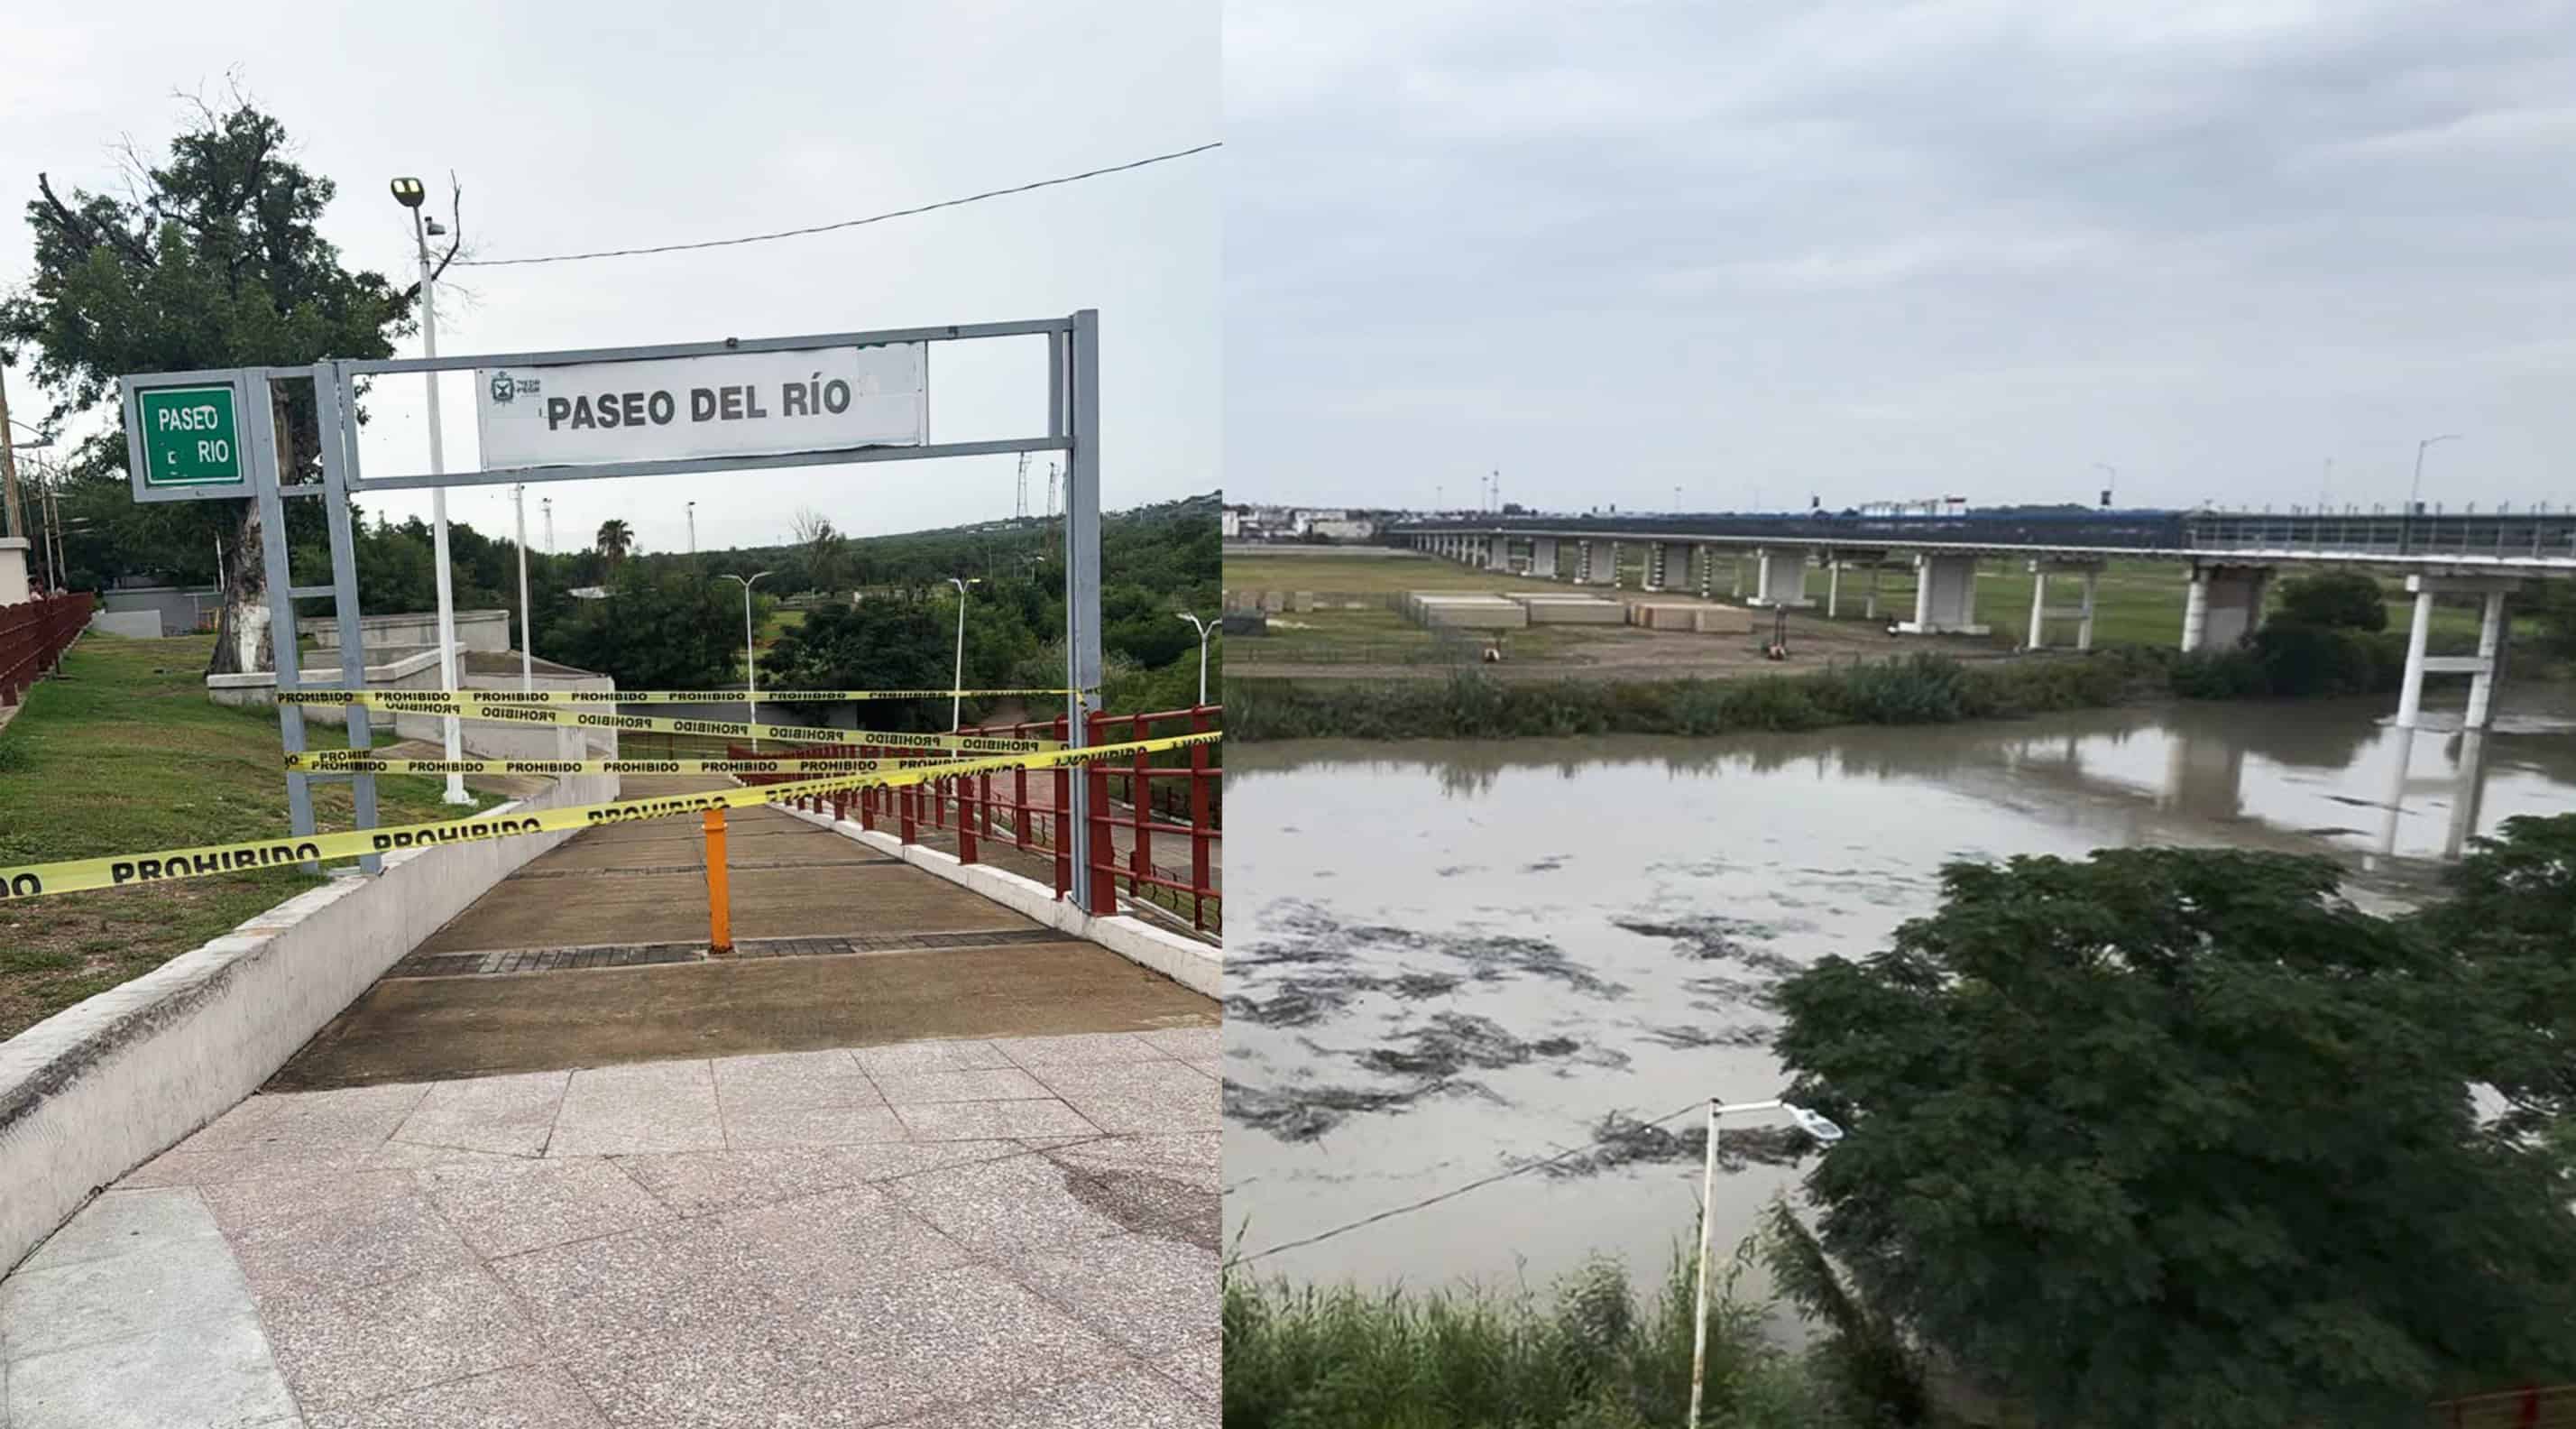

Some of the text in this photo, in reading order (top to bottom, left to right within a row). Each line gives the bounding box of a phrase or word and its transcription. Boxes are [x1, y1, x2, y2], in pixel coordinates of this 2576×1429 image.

[547, 372, 851, 430] PASEO DEL RÍO
[158, 405, 218, 431] PASEO
[198, 440, 229, 463] RIO
[278, 693, 354, 704] PROHIBIDO
[375, 692, 451, 701] PROHIBIDO
[473, 692, 549, 702] PROHIBIDO
[571, 692, 648, 701] PROHIBIDO
[311, 761, 387, 771] PROHIBIDO
[409, 761, 483, 771] PROHIBIDO
[506, 761, 582, 772] PROHIBIDO
[603, 761, 679, 772] PROHIBIDO
[701, 761, 777, 771] PROHIBIDO
[800, 761, 878, 770] PROHIBIDO
[111, 843, 320, 884] PROHIBIDO
